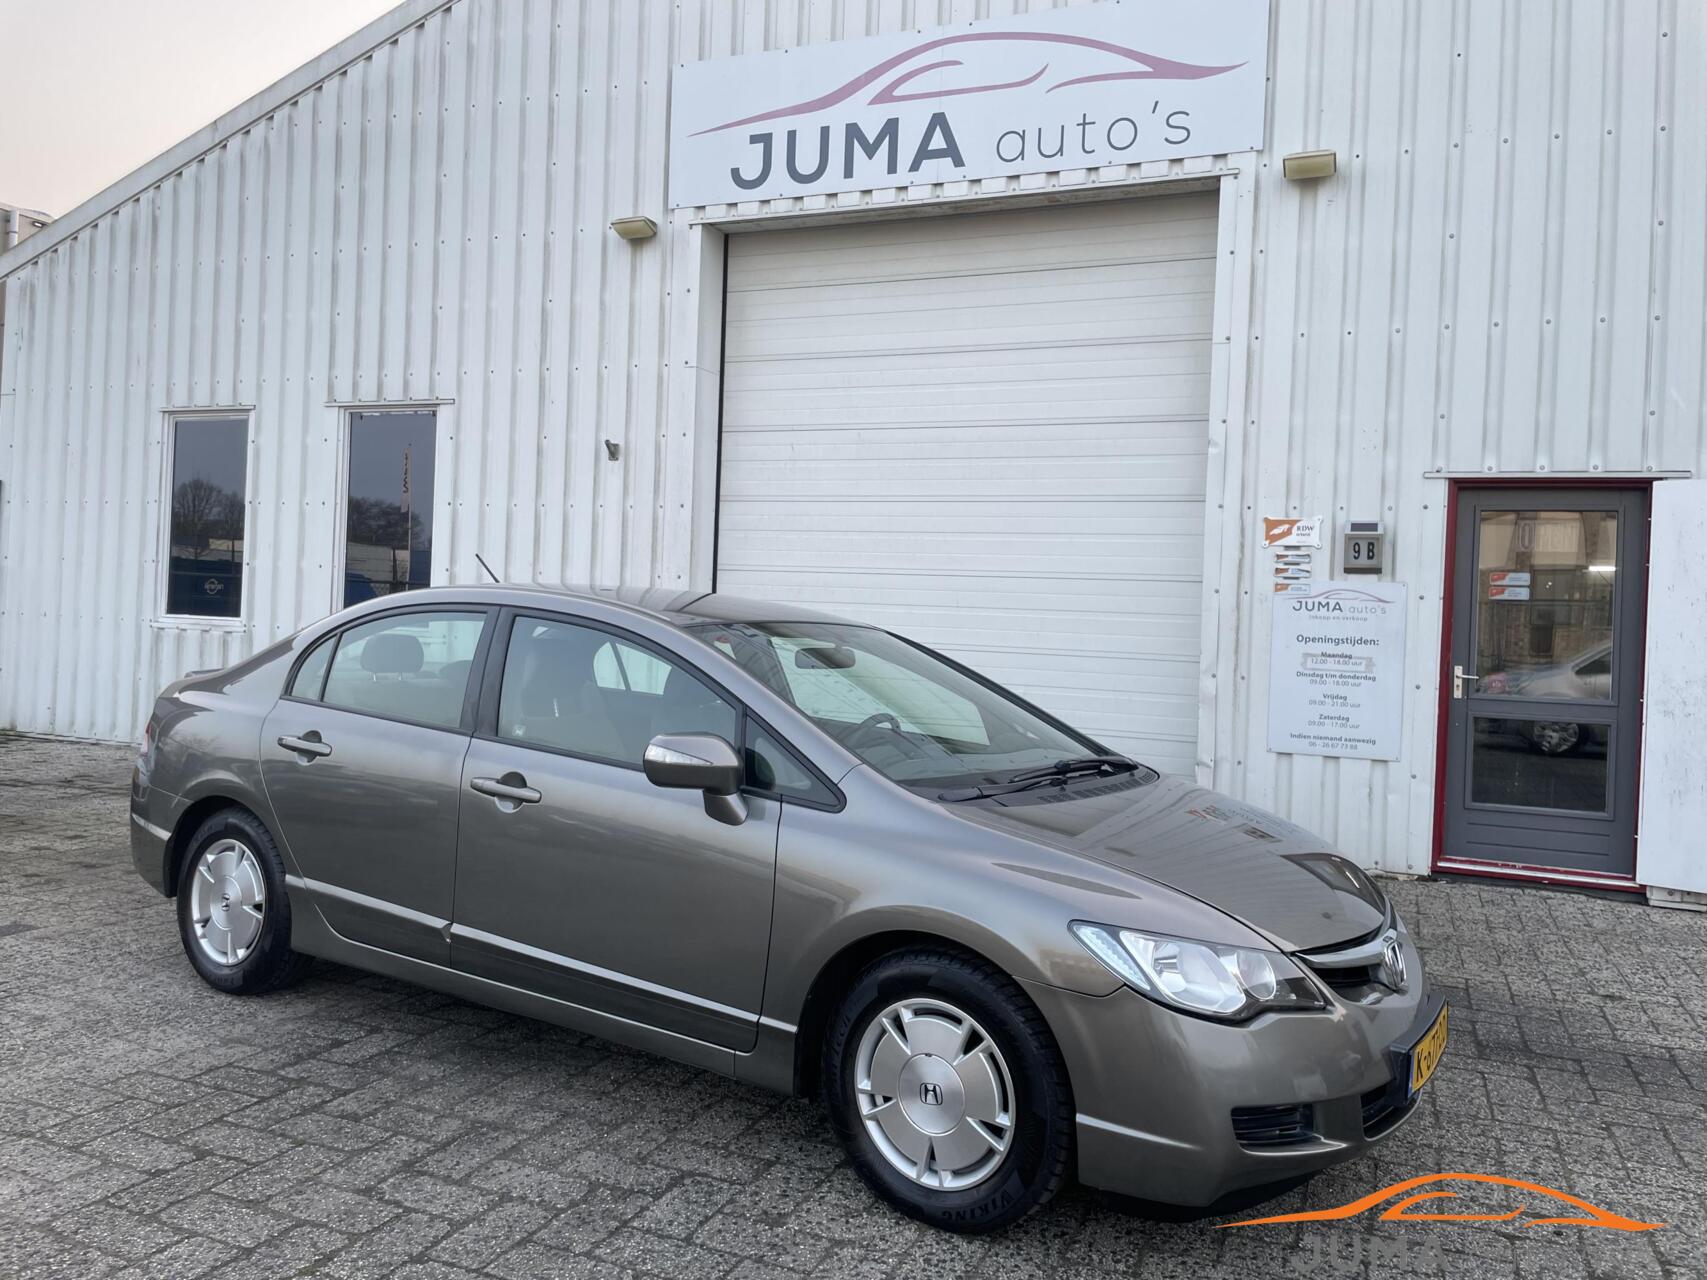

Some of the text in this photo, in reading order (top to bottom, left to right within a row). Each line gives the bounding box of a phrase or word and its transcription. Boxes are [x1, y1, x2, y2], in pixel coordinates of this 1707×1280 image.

[730, 100, 1192, 190] JUMA auto's
[1292, 600, 1387, 615] JUMA auto's
[1296, 634, 1380, 647] Openingstijden:
[1320, 651, 1353, 660] Maandag
[1296, 671, 1324, 680] Dinsdag
[1338, 674, 1377, 682] donderdag
[1322, 693, 1348, 701] Vrijdag
[1318, 713, 1350, 722] Zaterdag
[1290, 732, 1376, 745] Indien niemand aanwezig
[941, 1187, 1016, 1222] VIKING
